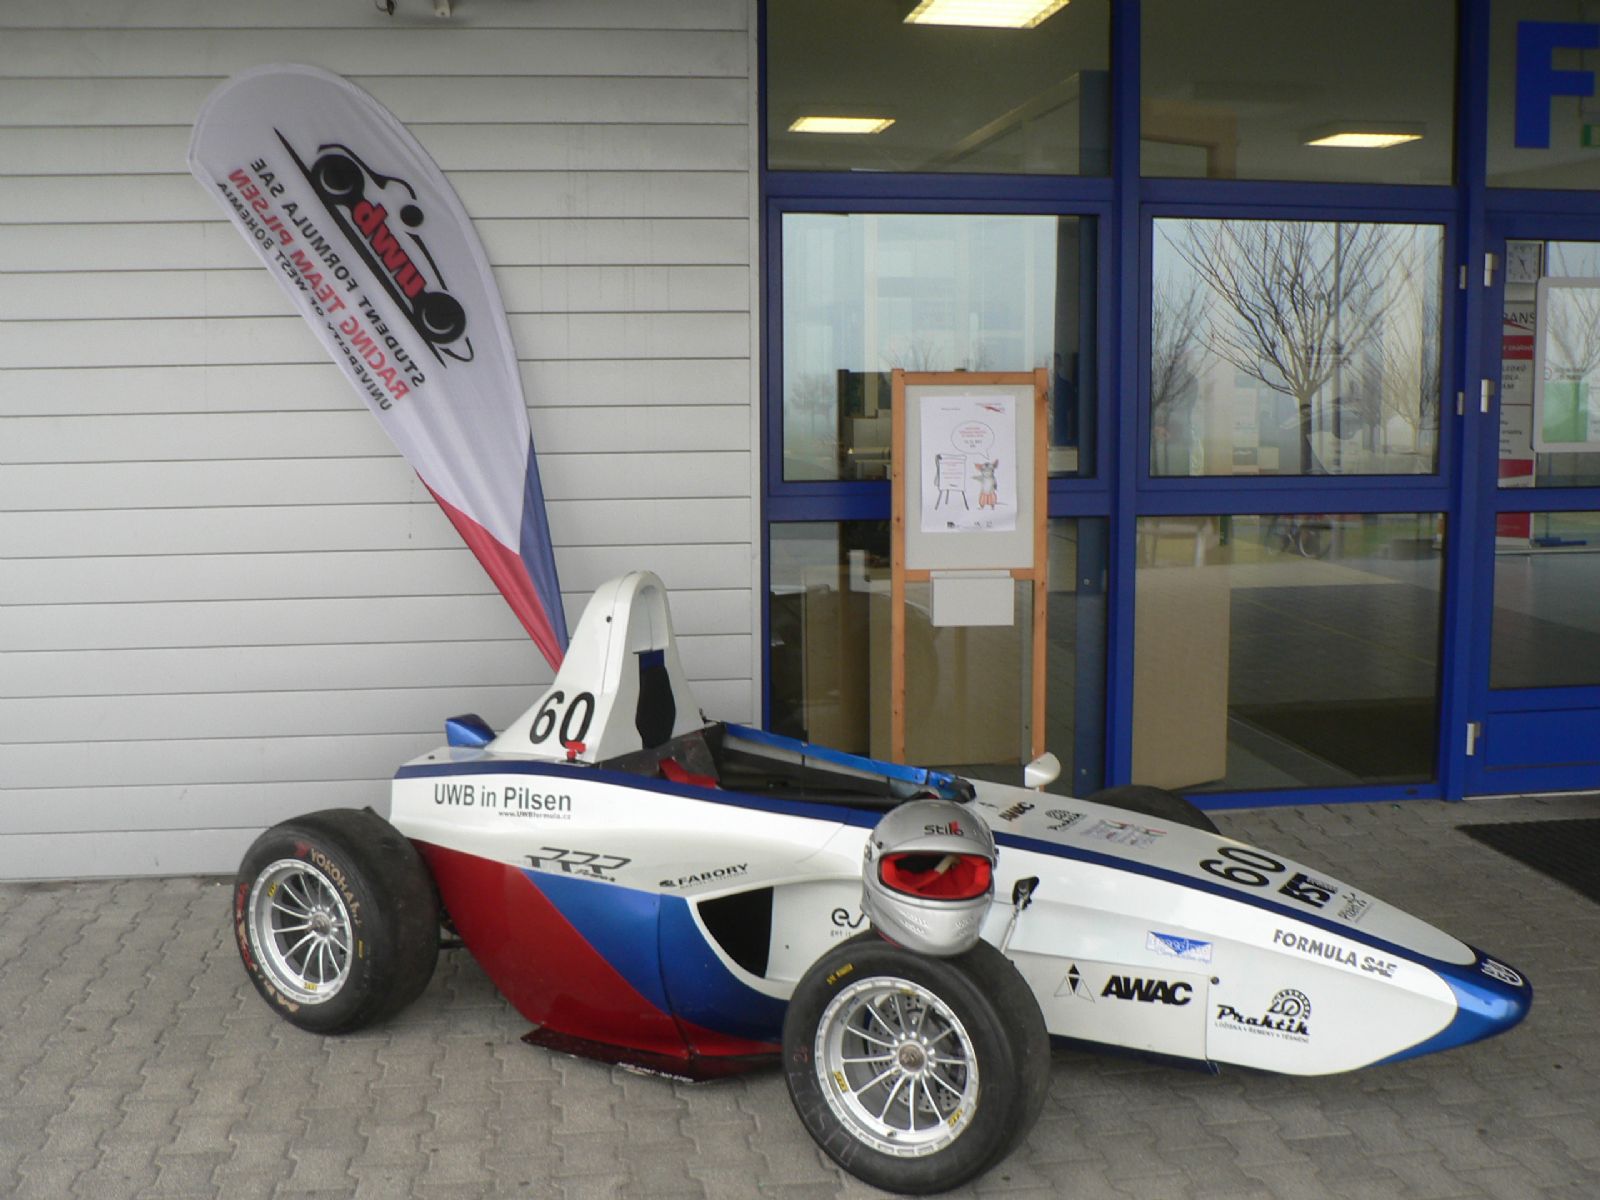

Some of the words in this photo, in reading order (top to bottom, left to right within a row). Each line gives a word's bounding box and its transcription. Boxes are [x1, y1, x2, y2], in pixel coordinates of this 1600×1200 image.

[529, 690, 596, 750] 60
[434, 783, 475, 806] UWB
[481, 785, 497, 808] in
[503, 786, 572, 812] Pilsen
[677, 862, 749, 886] FABORY
[1199, 846, 1287, 888] 60
[1273, 928, 1358, 968] FORMULA
[1360, 955, 1399, 979] SAE
[1101, 974, 1193, 1007] AWAC
[1217, 1003, 1311, 1036] Praktik
